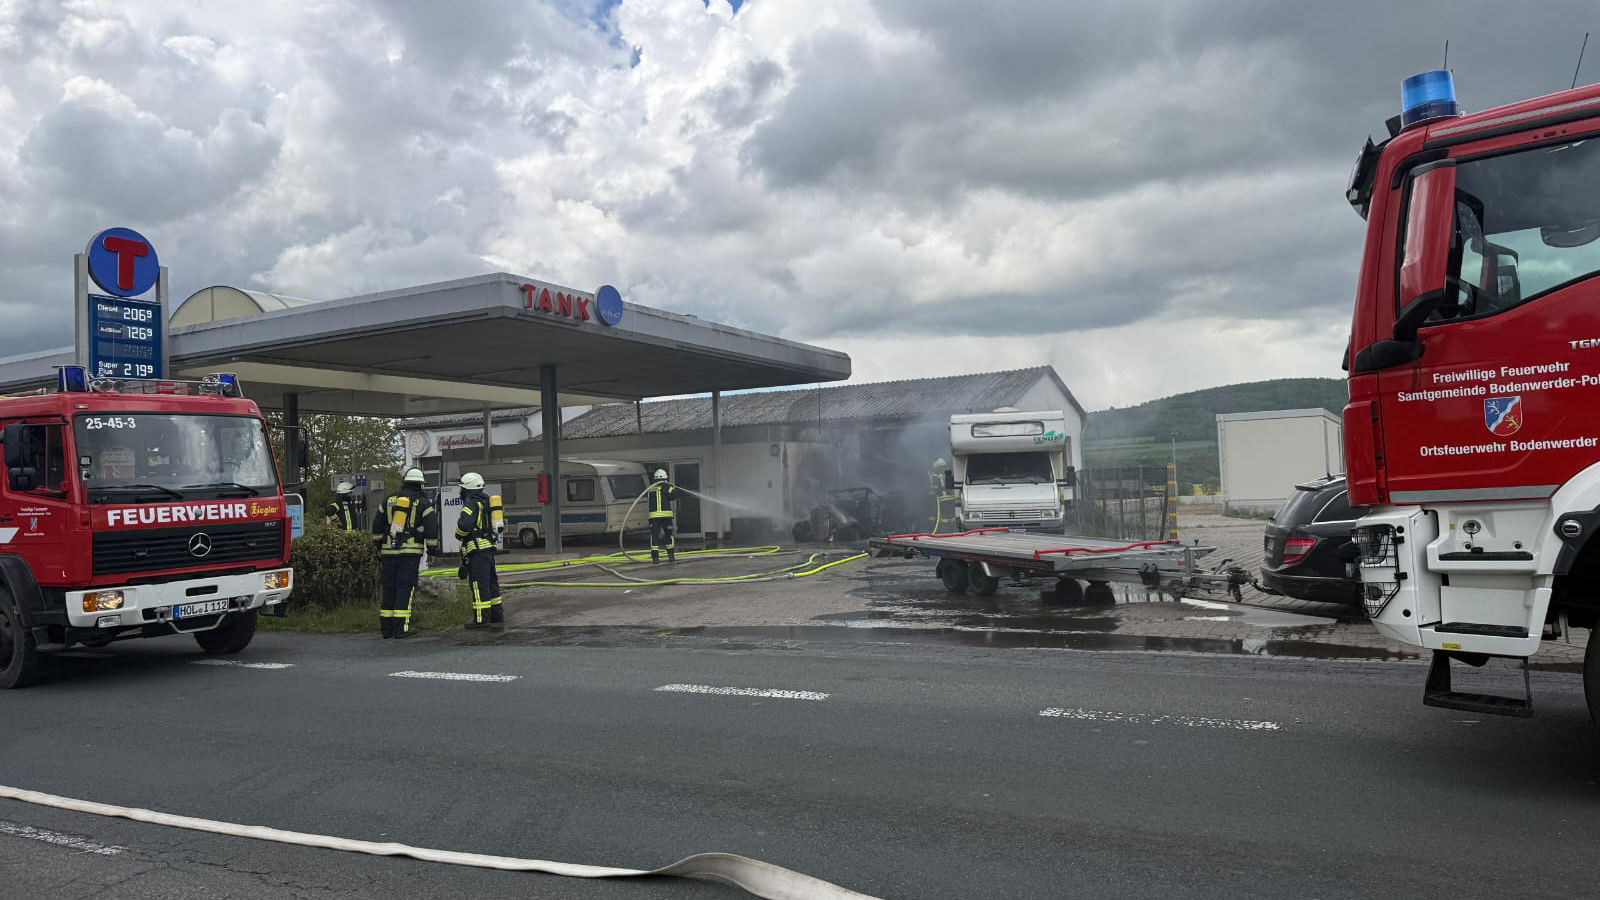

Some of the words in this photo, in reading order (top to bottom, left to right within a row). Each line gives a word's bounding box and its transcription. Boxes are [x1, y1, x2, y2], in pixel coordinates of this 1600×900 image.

[103, 236, 148, 290] T
[97, 303, 118, 313] Diesel
[523, 284, 590, 320] TANK
[98, 360, 118, 369] Super
[98, 367, 113, 375] Plus
[1432, 368, 1496, 384] Freiwillige
[1500, 361, 1570, 378] Feuerwehr
[1397, 384, 1486, 402] Samtgemeinde
[85, 417, 136, 430] 25-45-3
[1420, 442, 1506, 457] Ortsfeuerwehr
[1510, 436, 1598, 452] Bodenwerder
[106, 503, 248, 527] FEUERWEHR
[250, 502, 278, 517] Ziegler
[180, 605, 197, 615] HOL
[211, 601, 226, 611] 112
